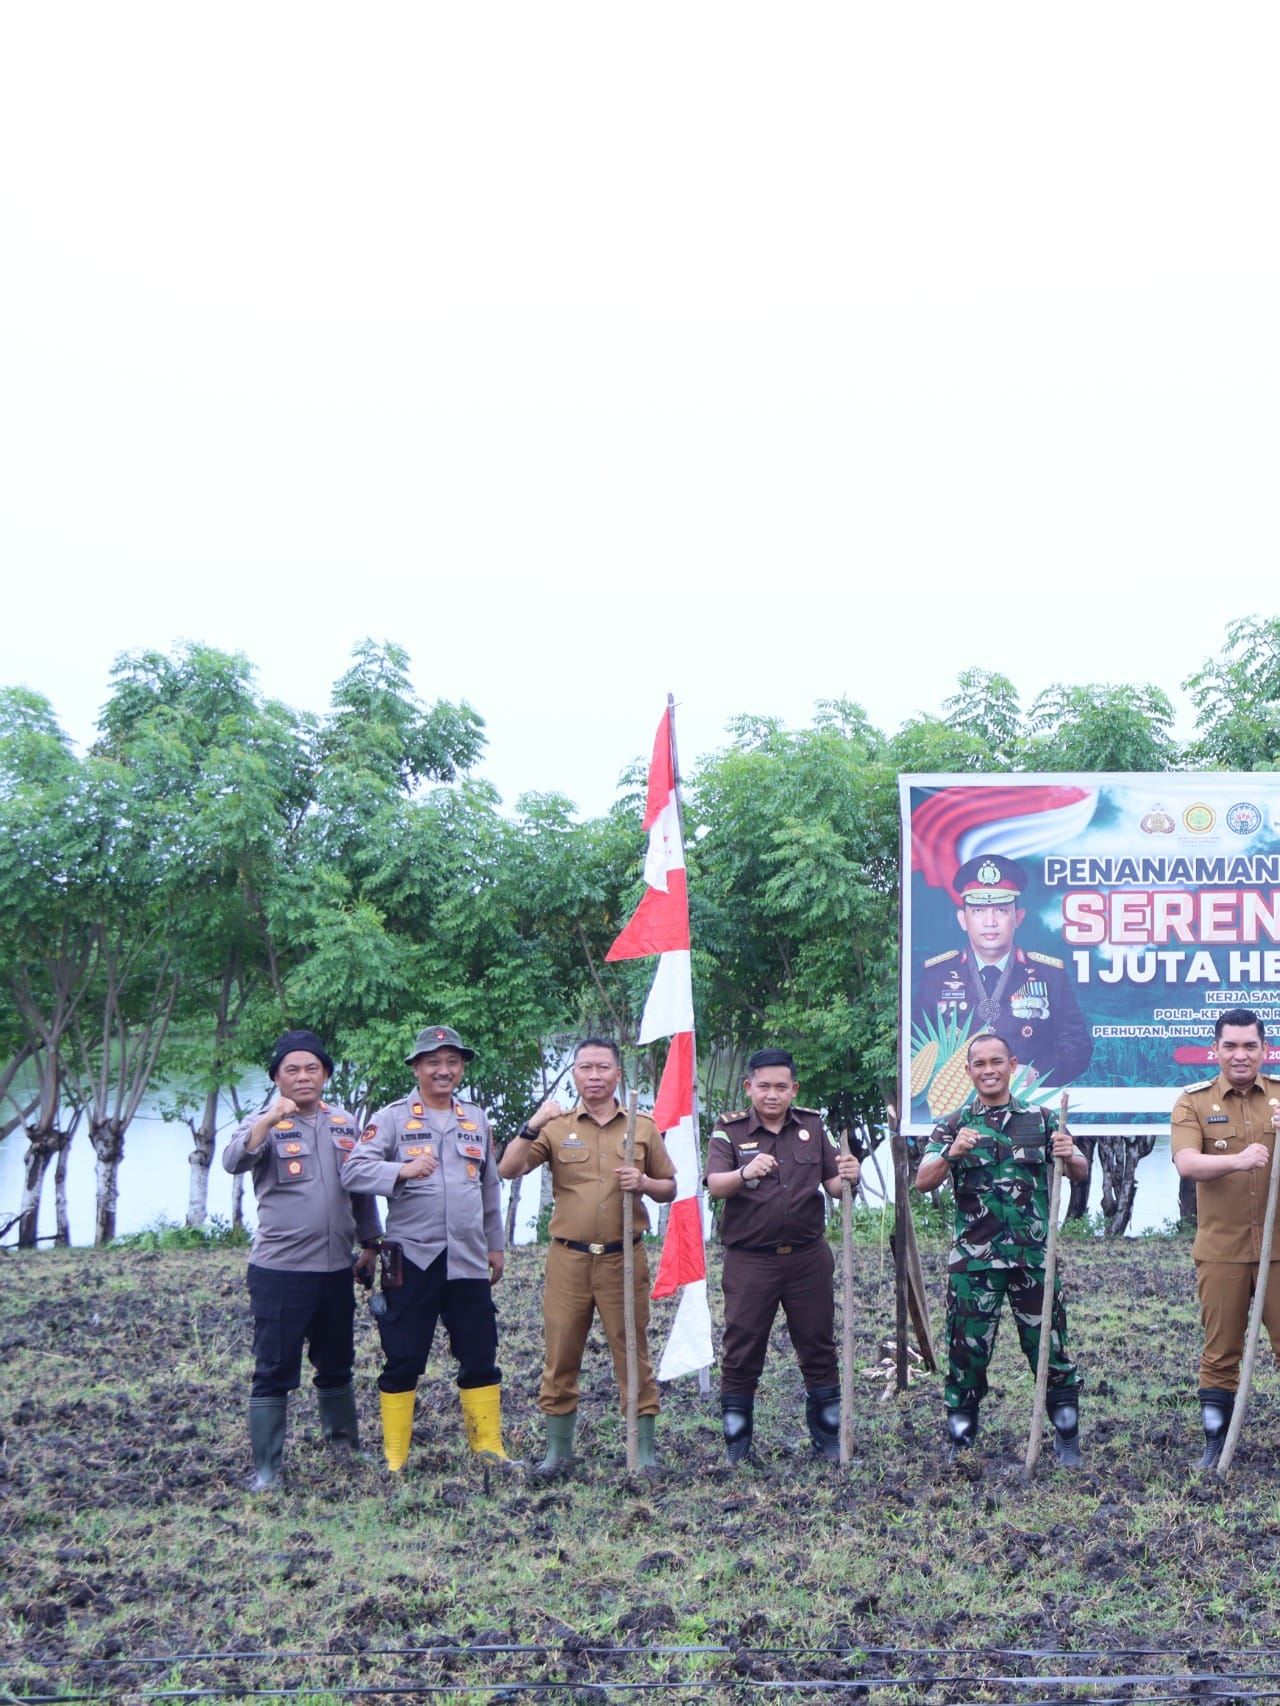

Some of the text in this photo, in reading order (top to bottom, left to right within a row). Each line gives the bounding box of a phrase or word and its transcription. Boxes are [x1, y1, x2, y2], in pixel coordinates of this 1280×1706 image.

[1045, 855, 1280, 885] PENANAMAN
[1072, 951, 1090, 983] 1
[1098, 951, 1221, 983] JUTA
[1206, 990, 1249, 1003] KERJA
[1154, 1008, 1194, 1020] POLRI
[1093, 1025, 1168, 1039] PERHUTANI,
[329, 1126, 355, 1135] POLRI
[457, 1132, 482, 1143] POLRI
